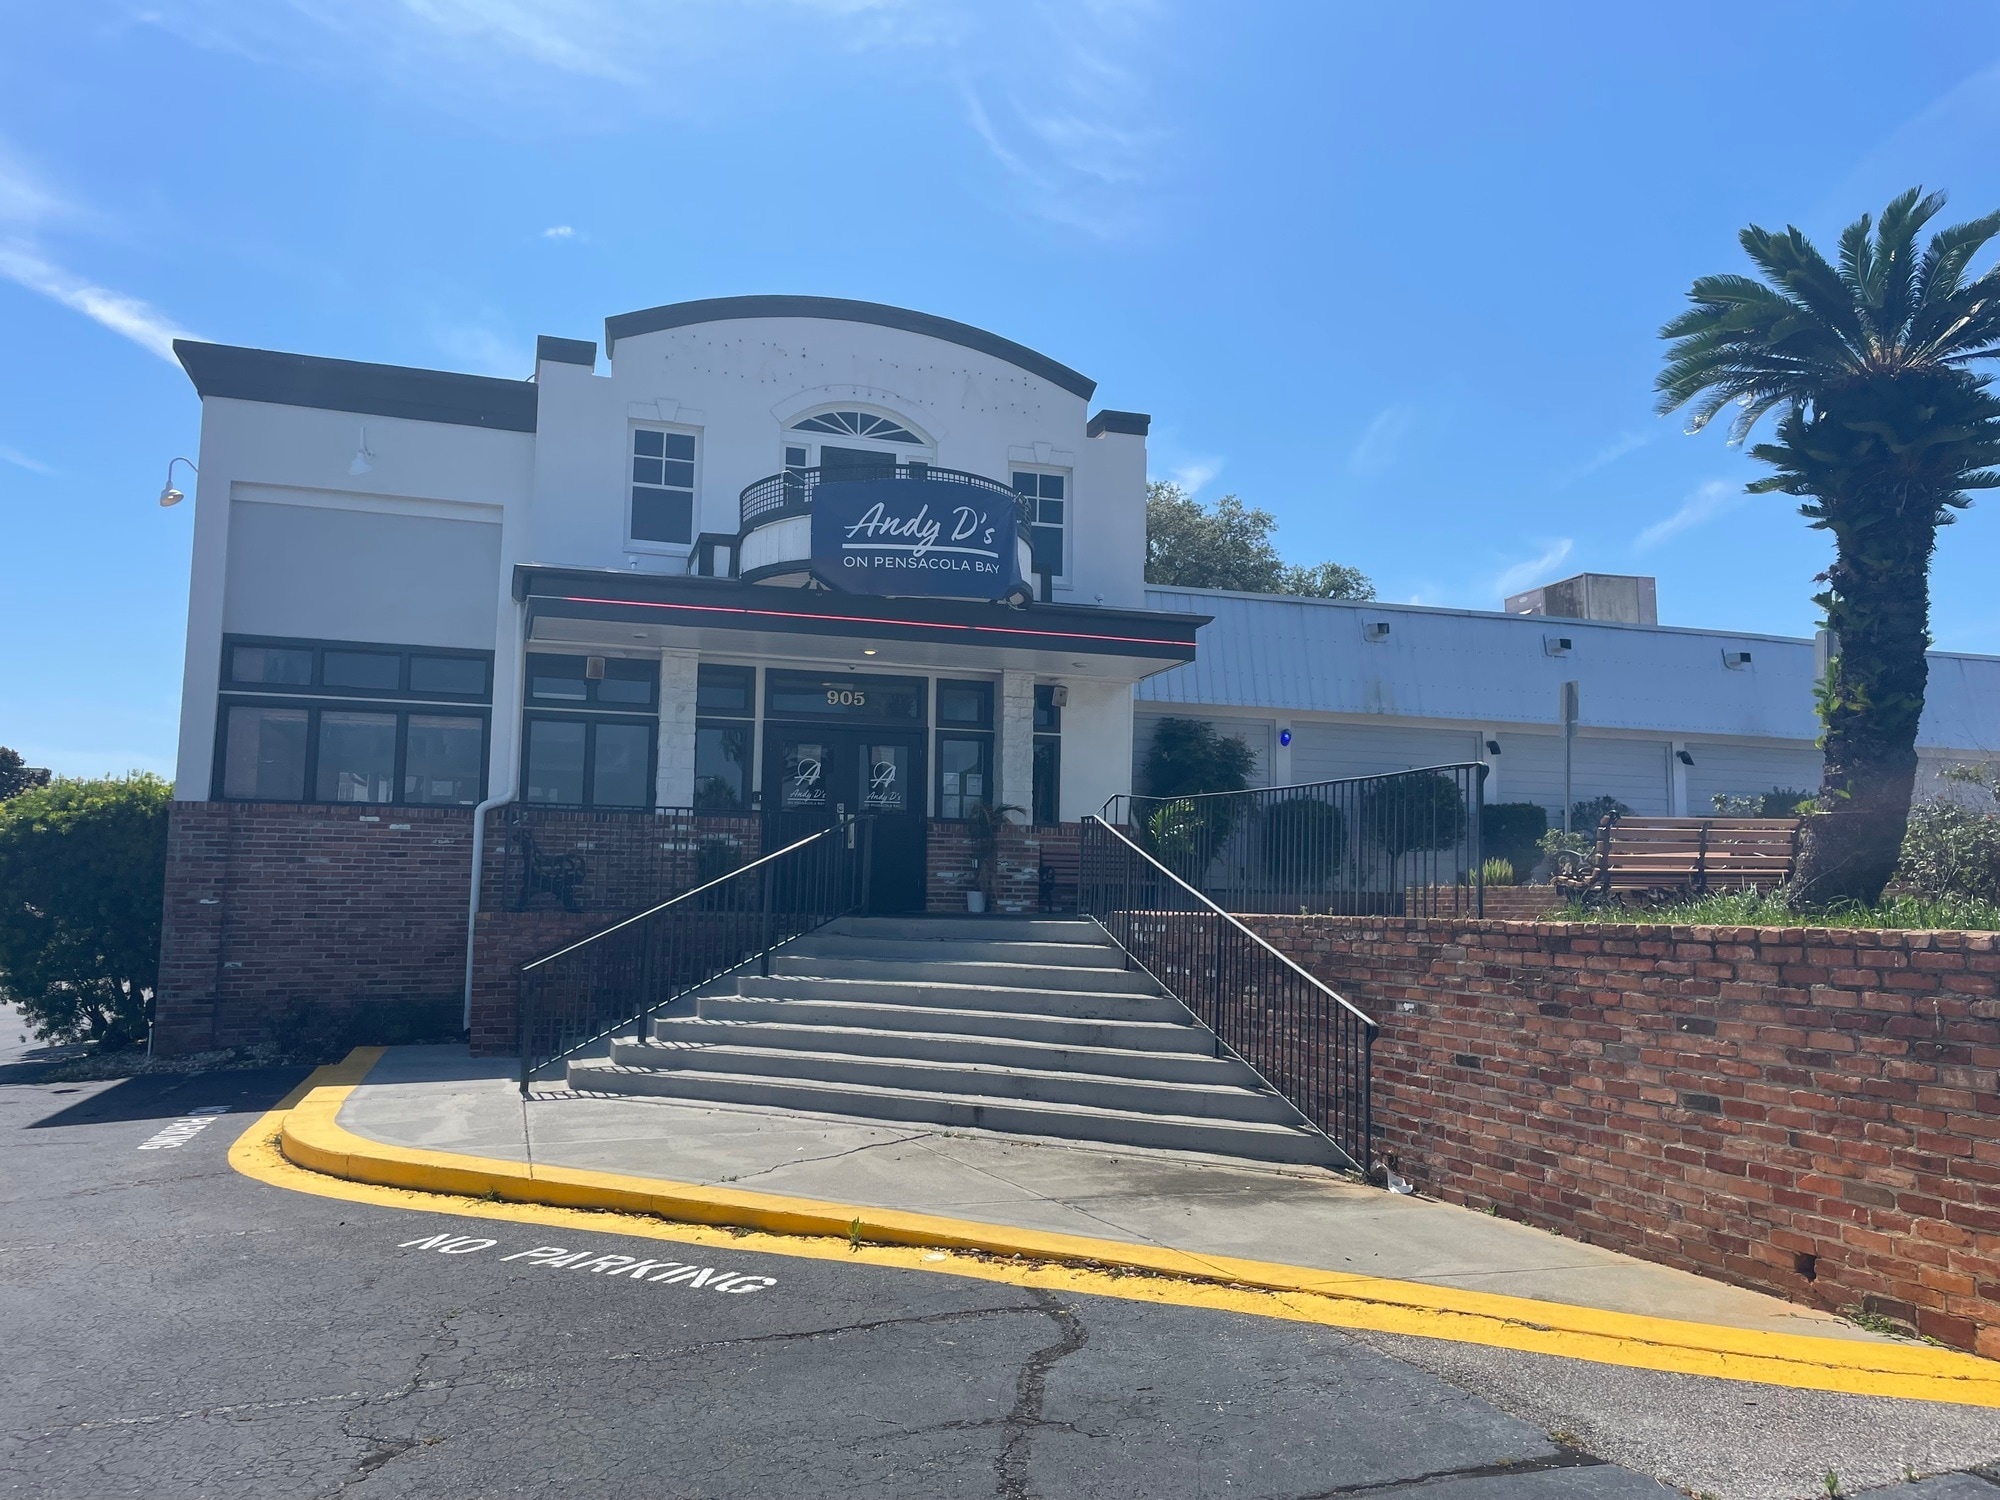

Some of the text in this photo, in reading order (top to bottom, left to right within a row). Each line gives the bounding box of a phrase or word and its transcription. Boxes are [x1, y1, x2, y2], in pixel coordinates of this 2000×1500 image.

[844, 502, 996, 557] Andy D's
[843, 556, 1000, 574] ON PENSACOLA BAY
[827, 690, 866, 706] 905
[790, 788, 827, 802] Andy D's
[866, 791, 902, 804] Andy D's
[137, 1116, 218, 1150] PARKING
[398, 1233, 778, 1294] NO PARKING
